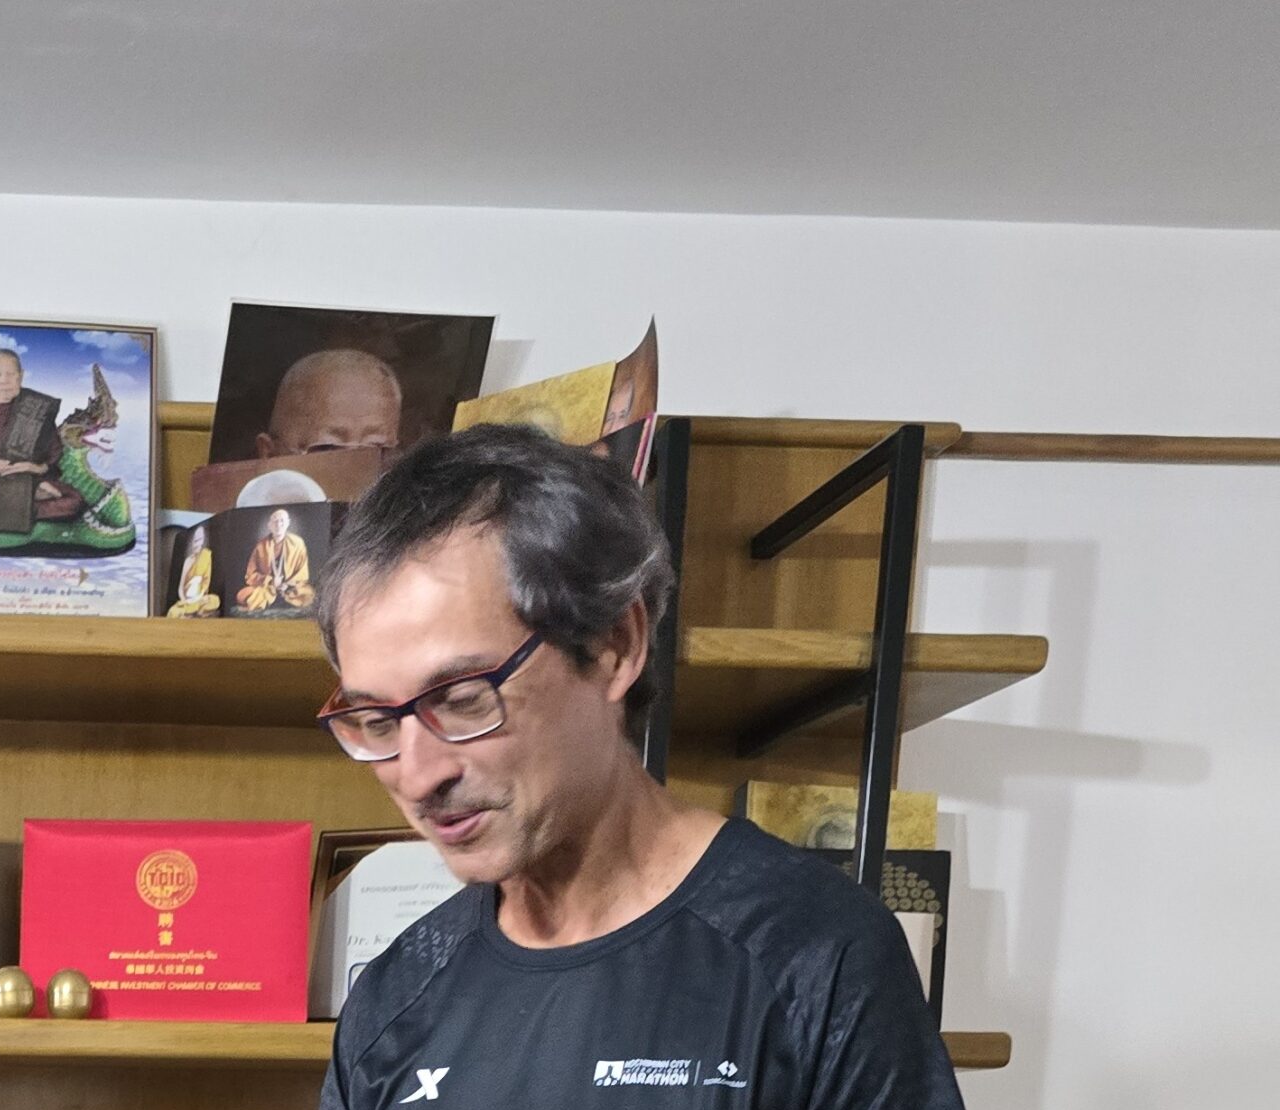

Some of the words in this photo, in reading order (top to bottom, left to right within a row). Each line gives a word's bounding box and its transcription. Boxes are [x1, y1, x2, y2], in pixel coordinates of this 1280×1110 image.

[120, 981, 166, 990] INVESTMENT
[167, 981, 205, 990] CHAMBER
[205, 981, 217, 990] OF
[218, 981, 261, 990] COMMERCE
[620, 1072, 689, 1086] MARATHON
